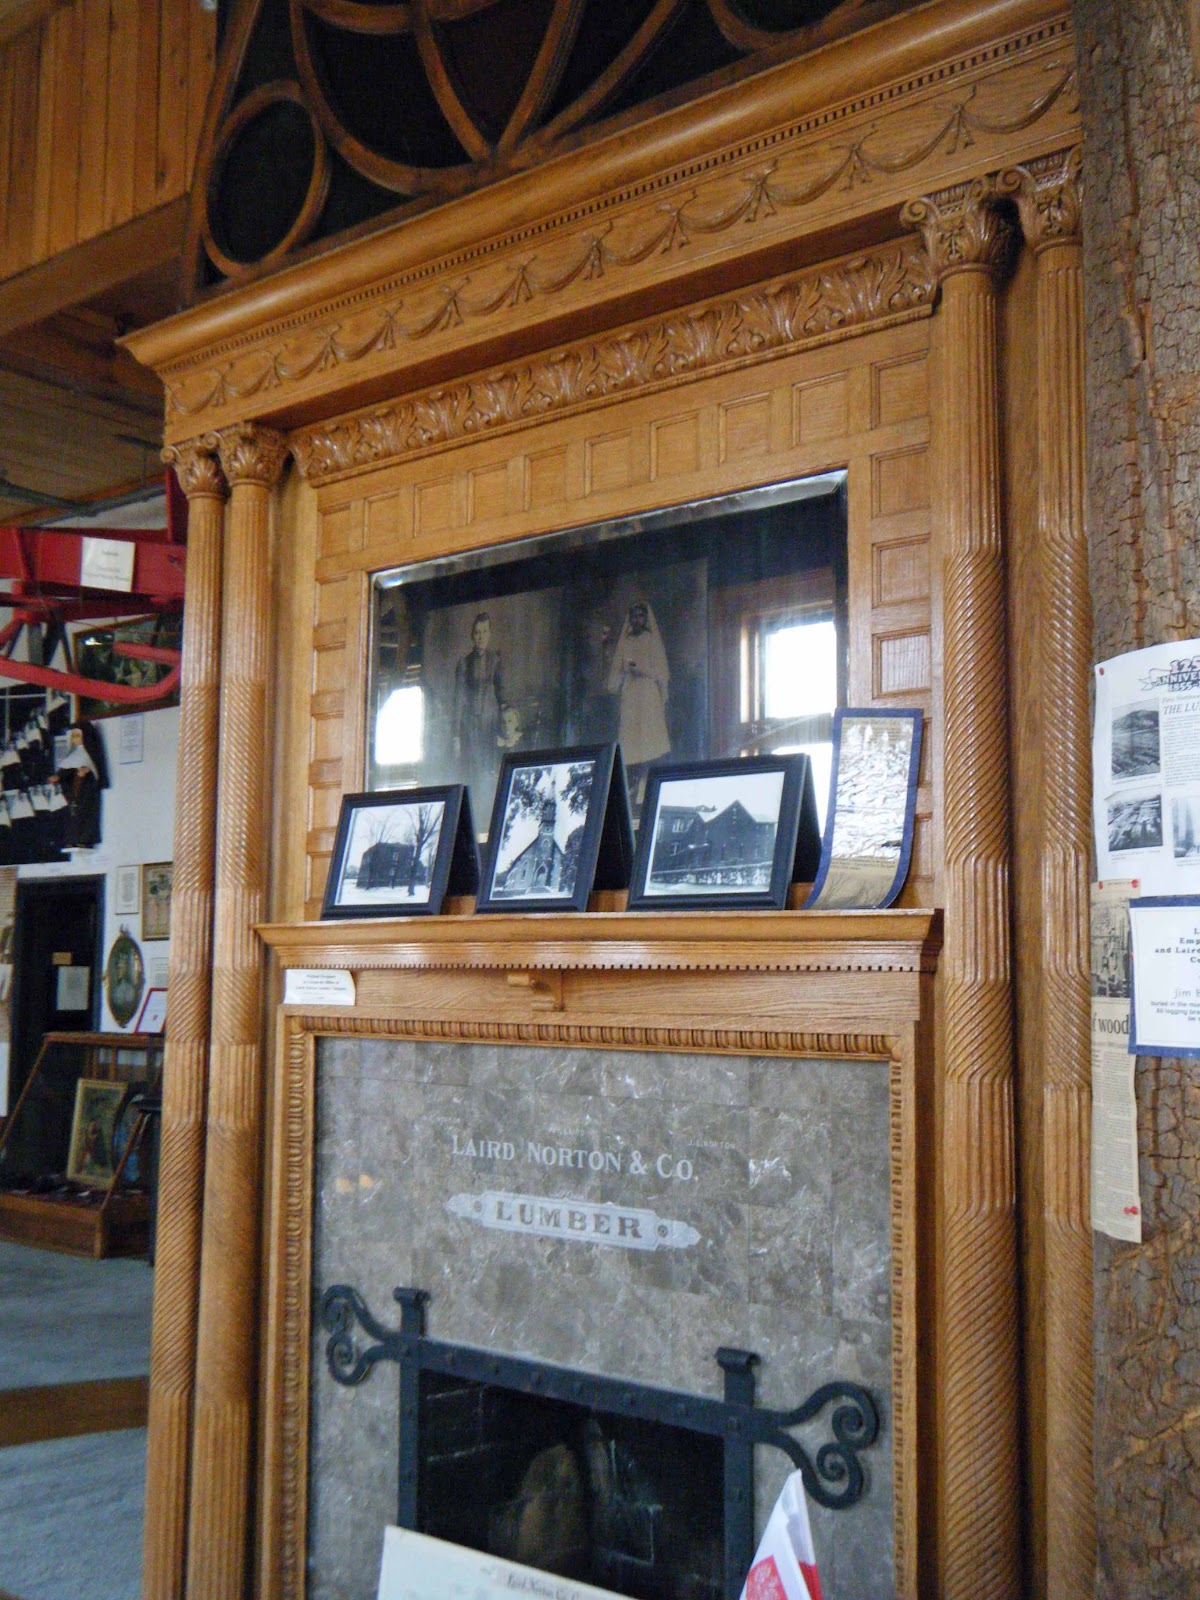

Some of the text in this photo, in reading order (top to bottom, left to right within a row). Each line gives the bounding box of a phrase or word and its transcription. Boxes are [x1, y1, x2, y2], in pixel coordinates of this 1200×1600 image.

[1164, 704, 1183, 715] THE
[1098, 1014, 1129, 1035] wood
[451, 1134, 515, 1161] LAIRD
[527, 1141, 622, 1173] NORTON
[629, 1150, 647, 1175] &
[496, 1201, 643, 1239] LUMBER
